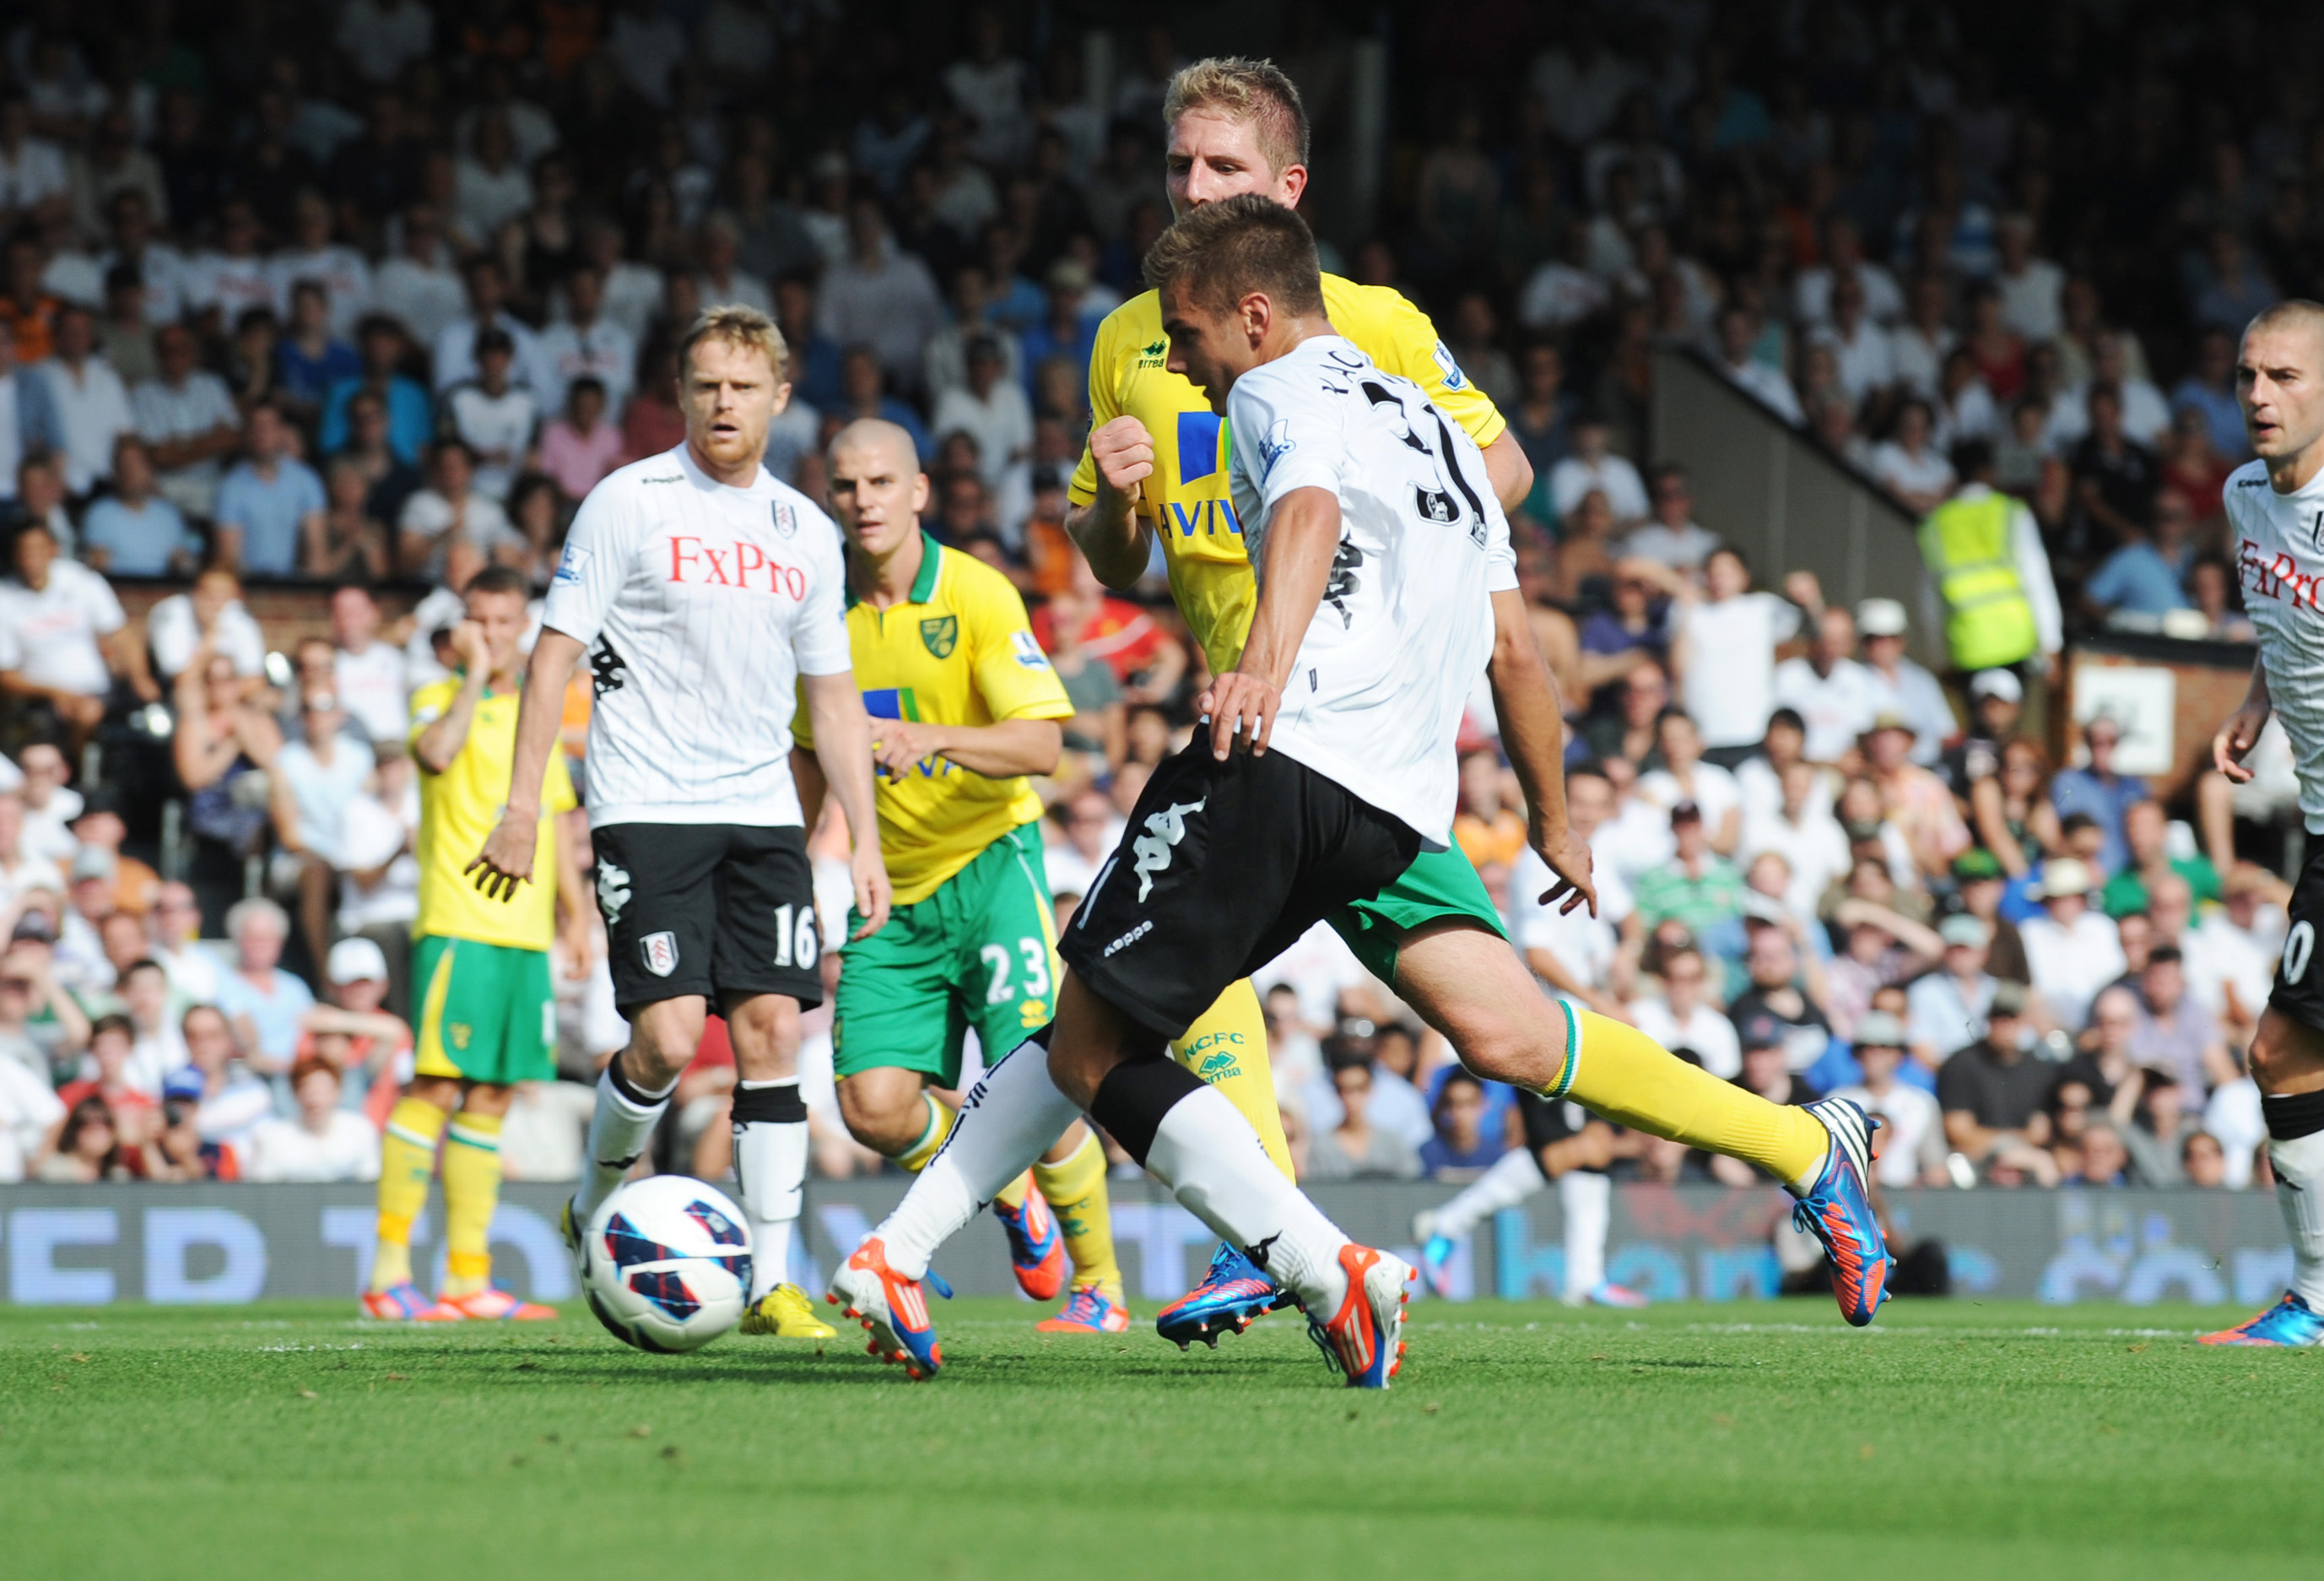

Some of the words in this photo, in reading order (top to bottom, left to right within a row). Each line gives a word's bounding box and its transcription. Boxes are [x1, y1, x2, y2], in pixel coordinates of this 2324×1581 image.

[667, 536, 805, 602] FxPro
[773, 902, 818, 971] 16
[979, 935, 1051, 1005] 23
[1184, 1032, 1245, 1062] NCFC
